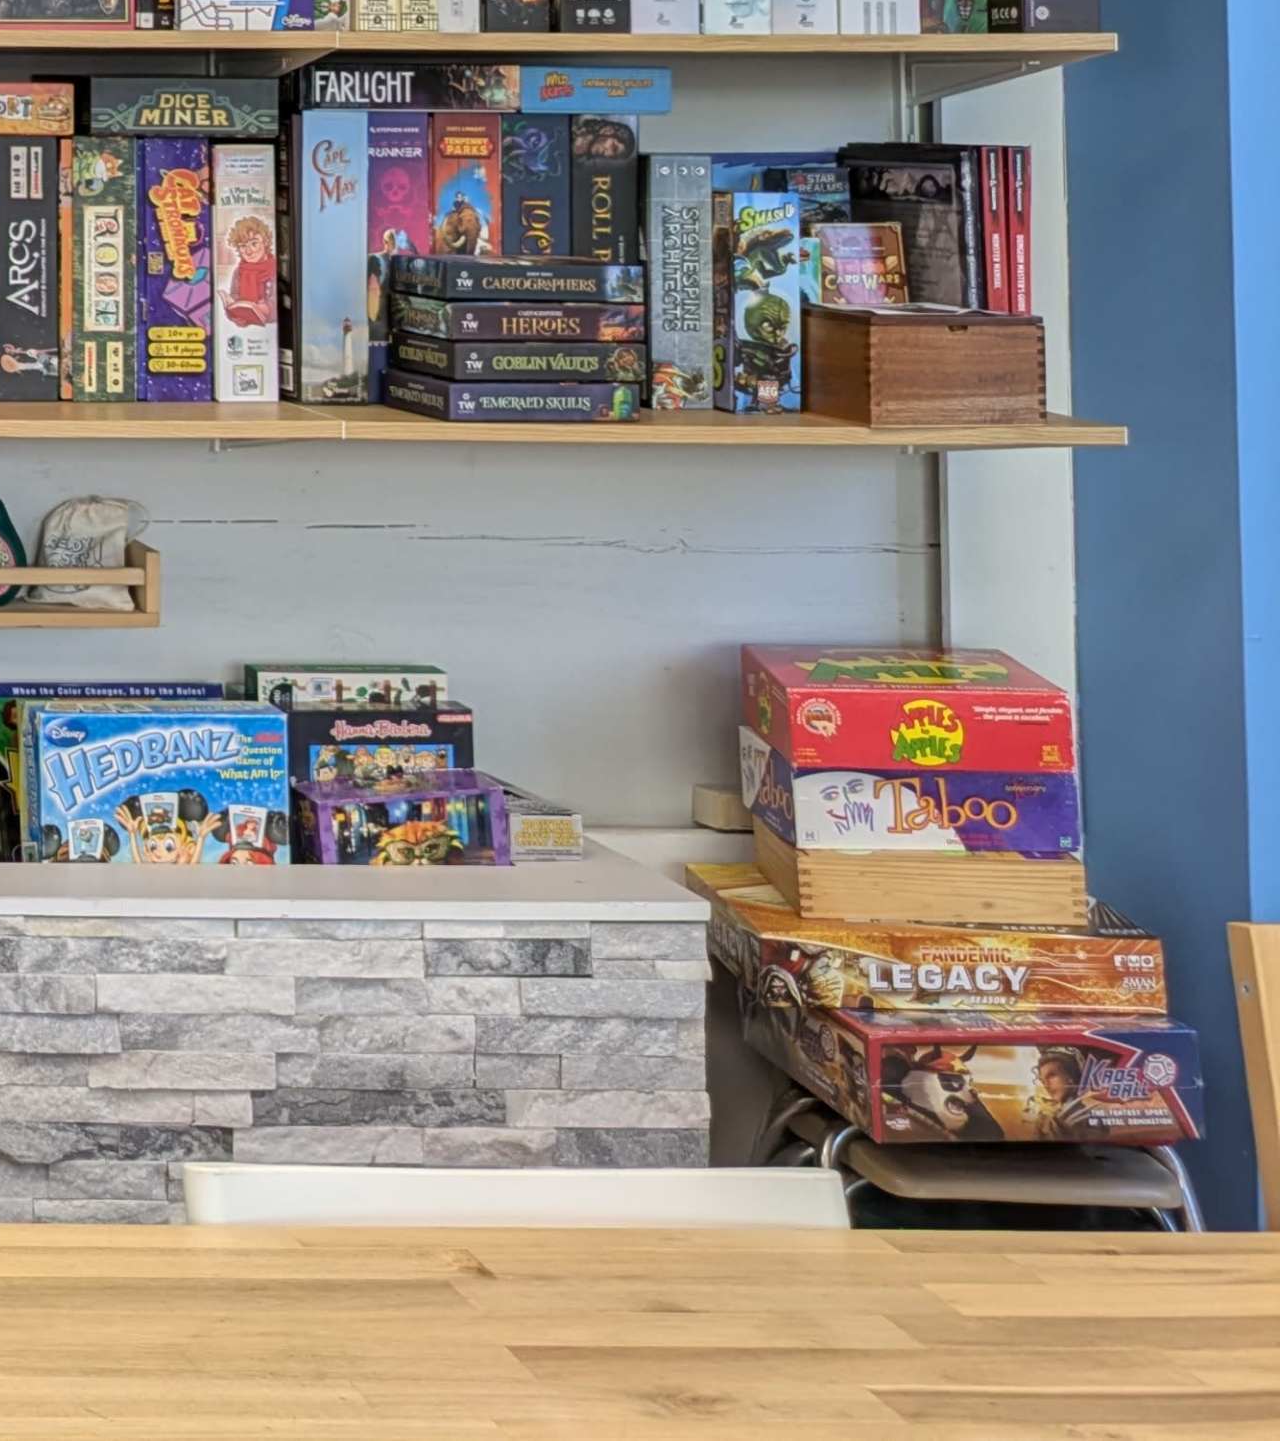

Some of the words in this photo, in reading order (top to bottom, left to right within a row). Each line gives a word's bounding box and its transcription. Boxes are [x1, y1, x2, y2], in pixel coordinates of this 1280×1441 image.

[315, 70, 414, 104] FARLIGHT
[159, 94, 211, 108] DICE
[140, 109, 229, 126] MINER
[446, 144, 489, 156] PARKS
[591, 175, 611, 233] ROLL
[739, 206, 784, 231] SMASH
[6, 219, 37, 316] ARCS
[662, 205, 681, 332] ARCHITECTS
[682, 206, 700, 332] STONESPINE
[482, 275, 597, 292] CARTOGRAPHERS
[825, 273, 860, 291] CARD
[862, 273, 901, 291] WARS
[501, 316, 581, 335] HEROES
[493, 355, 547, 371] GOBLIN
[549, 353, 598, 371] VAULTS
[479, 396, 543, 410] EMERALD
[546, 396, 590, 410] SKULLS
[12, 686, 37, 696] When
[40, 686, 55, 696] the
[57, 686, 82, 696] Color
[129, 686, 142, 696] So
[143, 686, 156, 696] Do
[159, 686, 173, 696] the
[176, 686, 206, 696] Rules!
[241, 745, 283, 756] Question
[892, 733, 963, 764] APPLES
[44, 728, 240, 812] HEDBANZ
[873, 777, 1019, 834] Taboo
[919, 945, 1013, 964] PANDEMIC
[867, 962, 1030, 994] LEGACY
